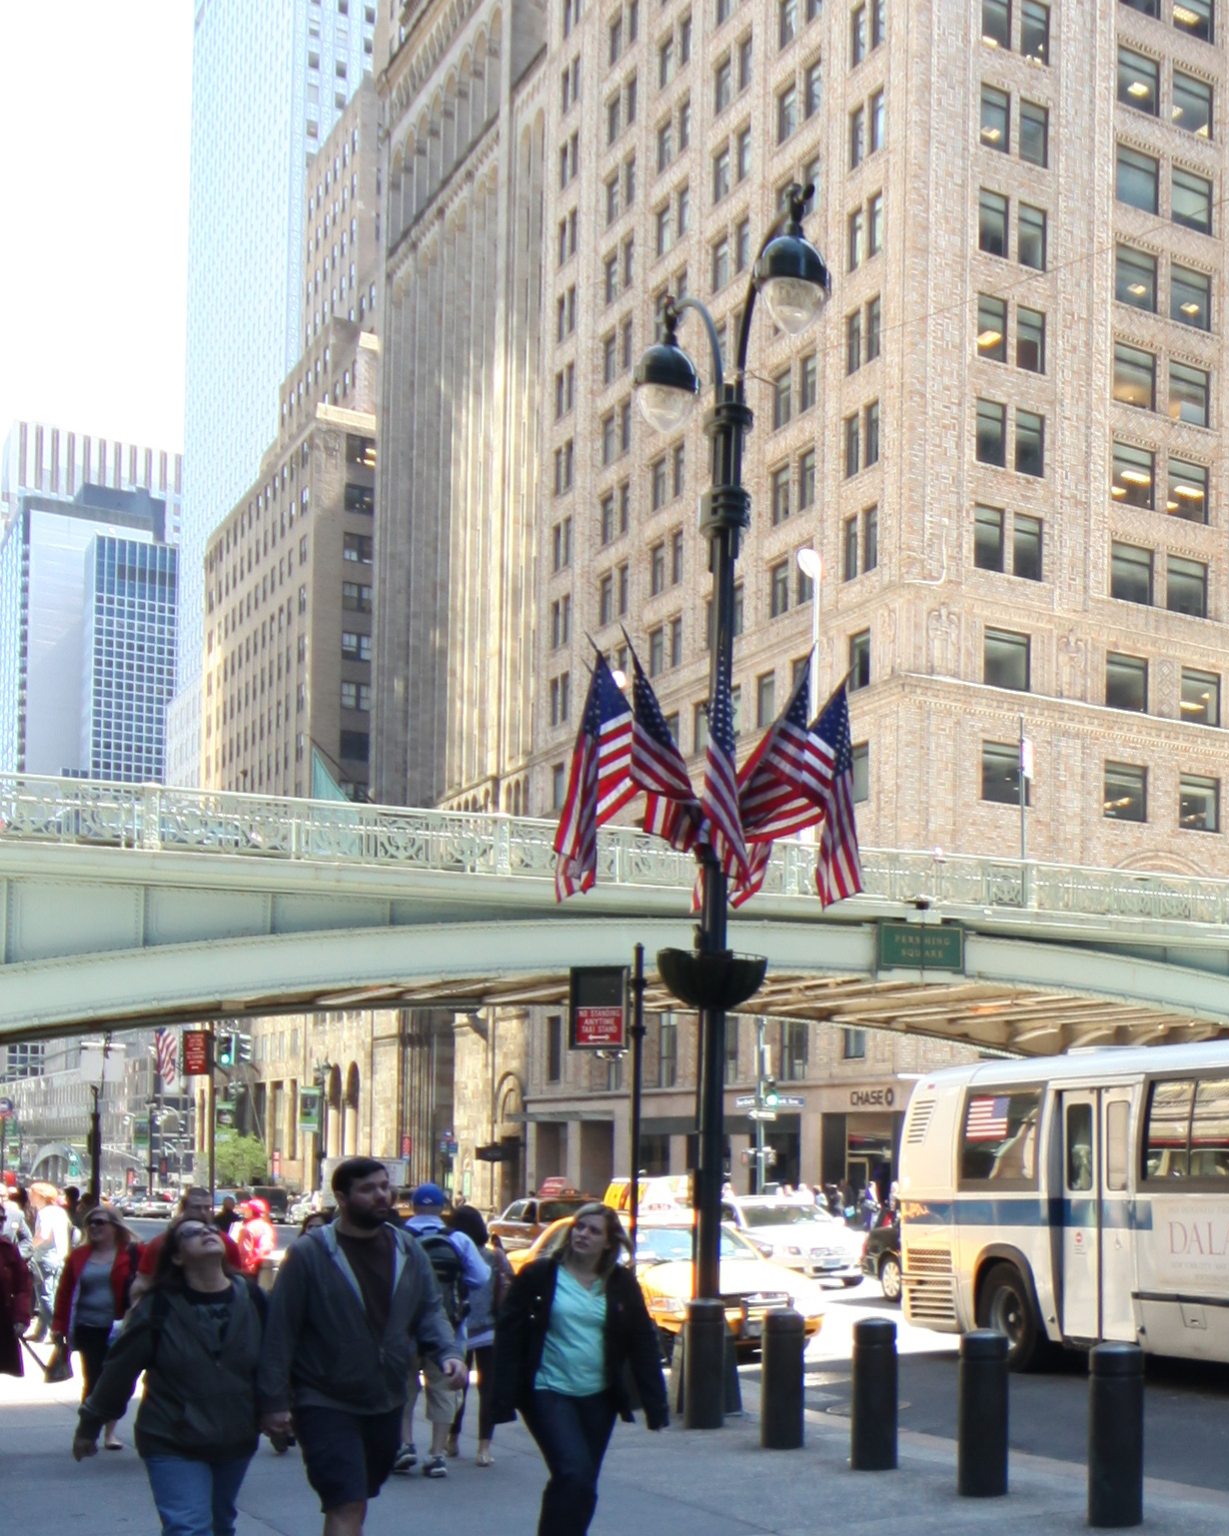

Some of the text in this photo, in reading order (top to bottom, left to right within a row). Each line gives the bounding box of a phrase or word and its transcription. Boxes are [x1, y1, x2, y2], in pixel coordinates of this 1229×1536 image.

[894, 934, 951, 946] PERSHING
[901, 948, 944, 959] SQUARE
[578, 1009, 621, 1017] NO STANDING
[583, 1017, 615, 1025] ANYTIME
[581, 1025, 618, 1033] TAXI STAND
[850, 1089, 884, 1106] CHASE
